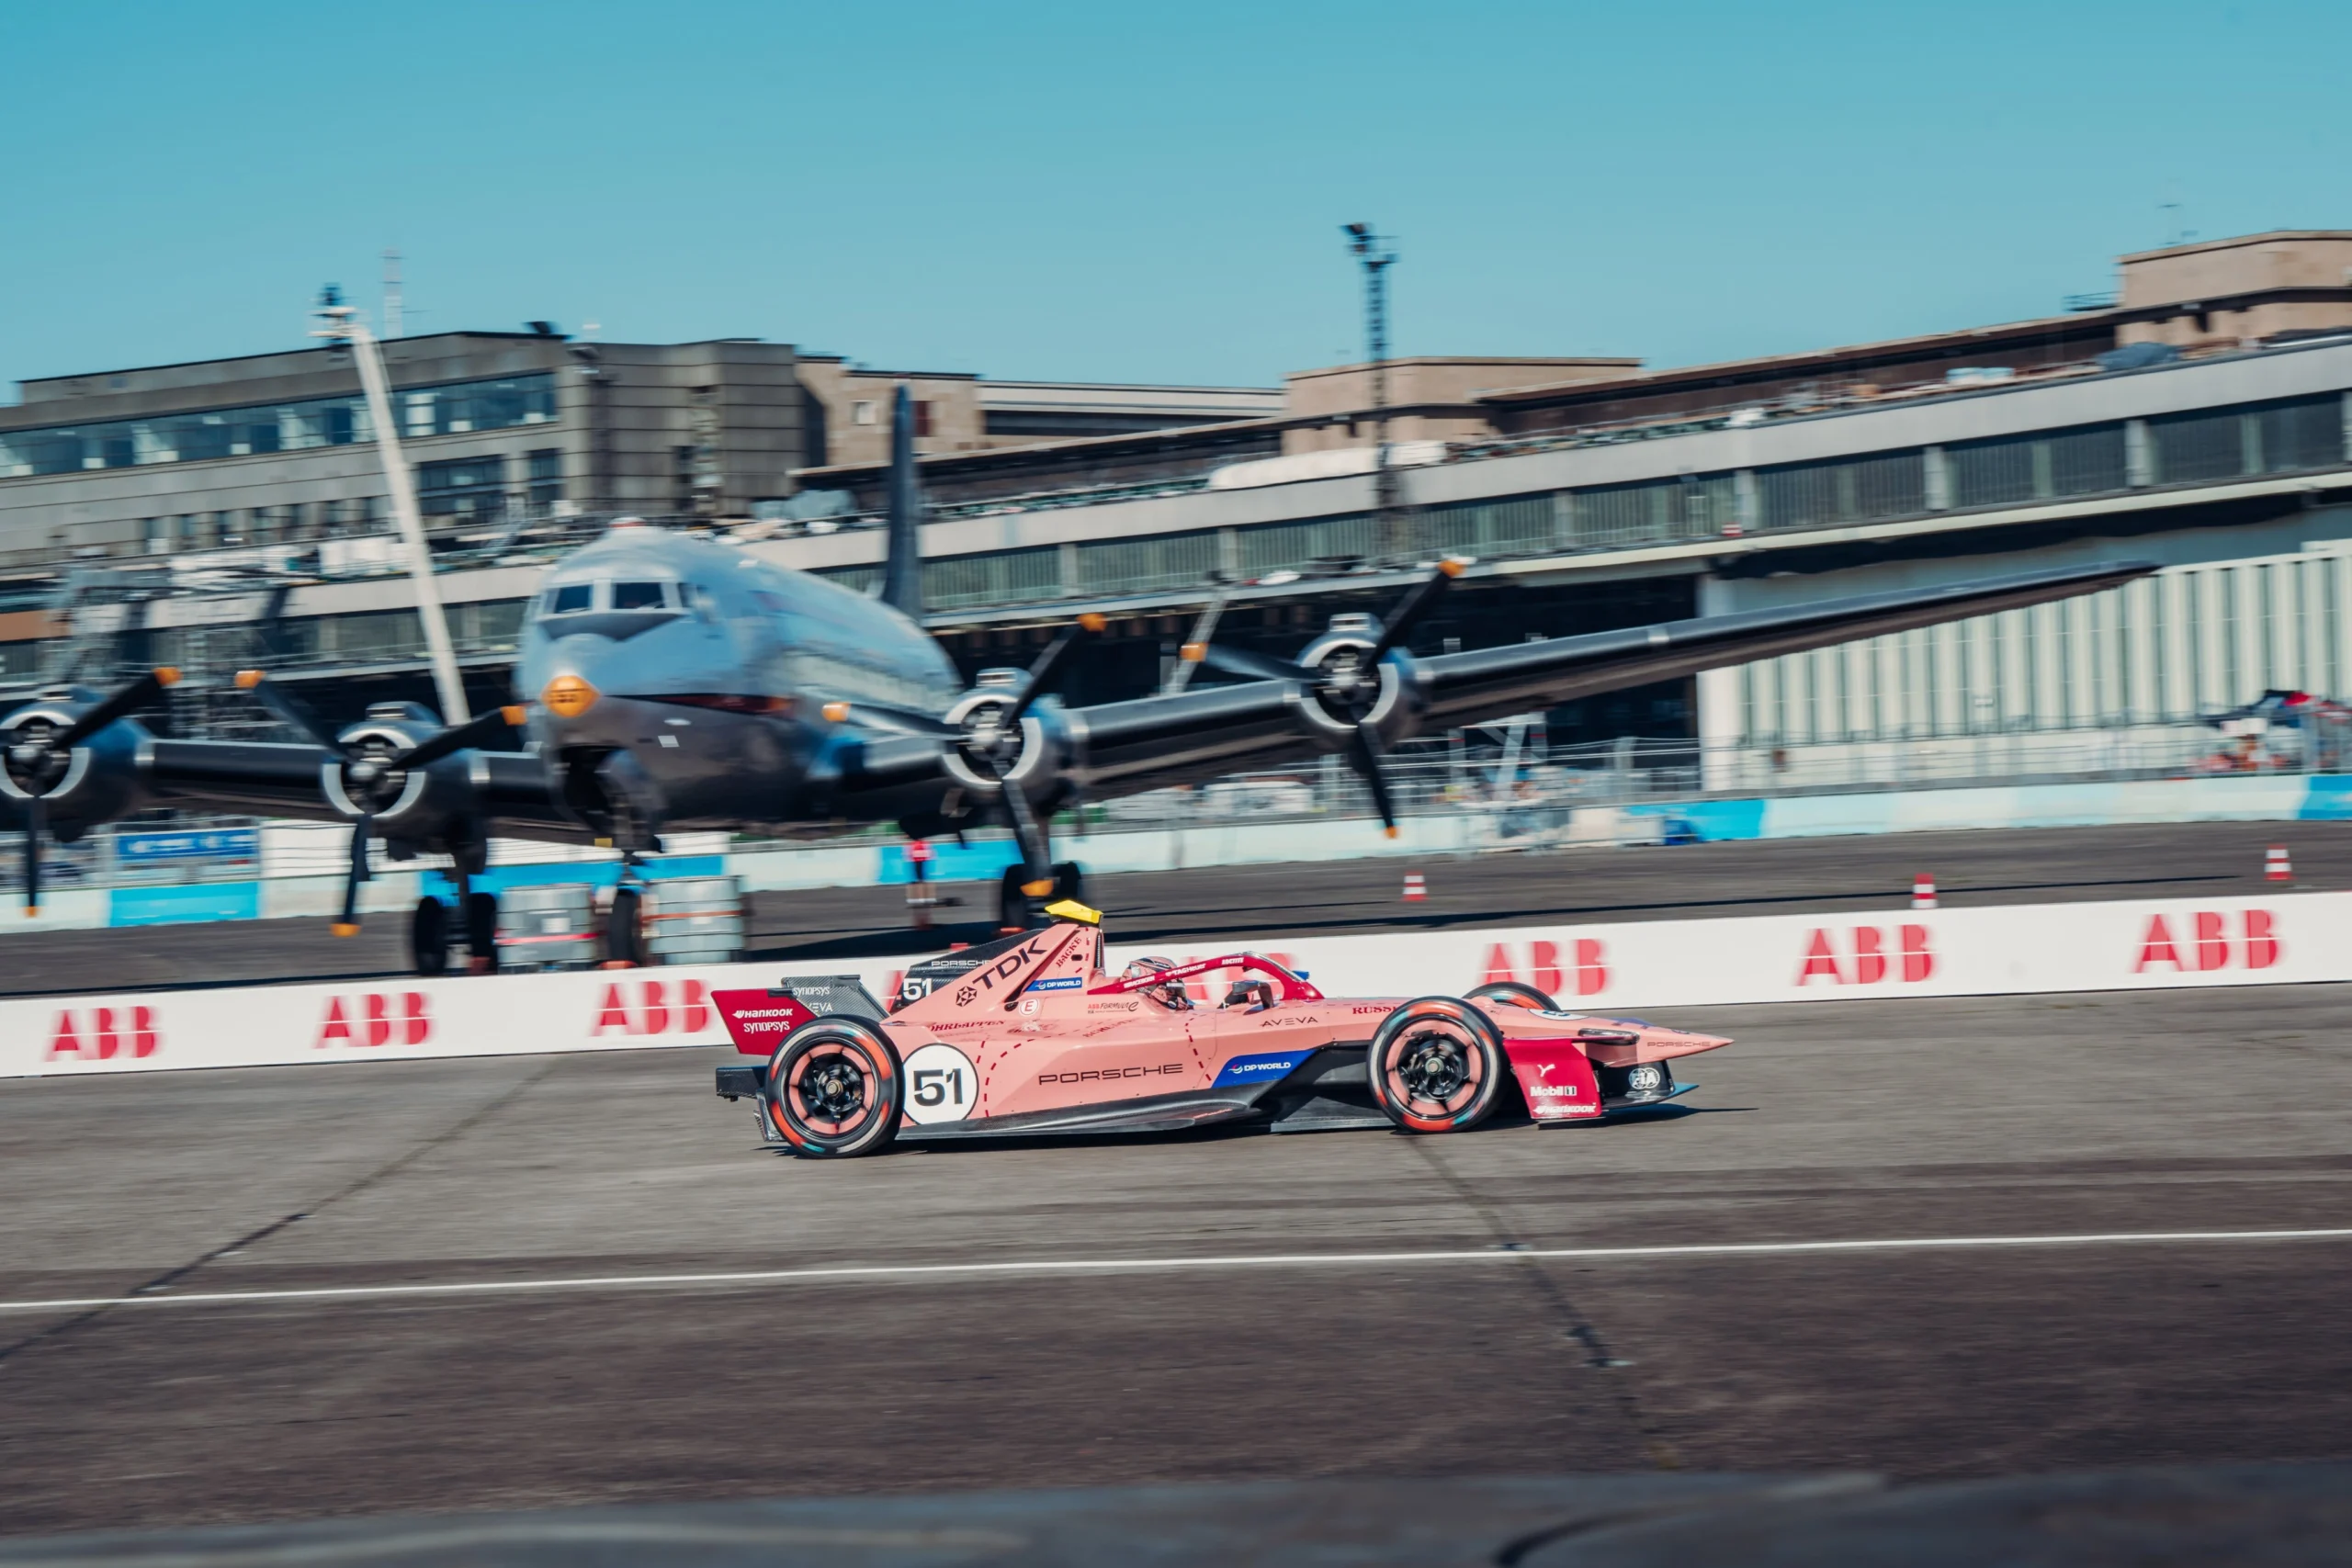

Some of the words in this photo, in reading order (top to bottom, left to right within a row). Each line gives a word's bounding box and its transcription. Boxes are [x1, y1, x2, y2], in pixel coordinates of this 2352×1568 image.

[2130, 908, 2284, 973] ABB
[972, 937, 1047, 989] TDK
[1794, 924, 1937, 986] ABB
[1481, 938, 1610, 996] ABB
[793, 987, 830, 997] SYNOPSYS
[902, 978, 933, 1000] 51
[1057, 979, 1081, 987] WORLD
[591, 978, 712, 1036] ABB
[1024, 1000, 1035, 1011] E
[317, 991, 435, 1048] ABB
[743, 1021, 790, 1034] SYNOPSYS
[1261, 1016, 1318, 1028] AVEVA
[44, 1005, 162, 1062] ABB
[1038, 1064, 1183, 1085] PORSCHE
[1260, 1062, 1291, 1070] WORLD
[913, 1067, 963, 1107] 51
[1531, 1086, 1564, 1096] Mobil
